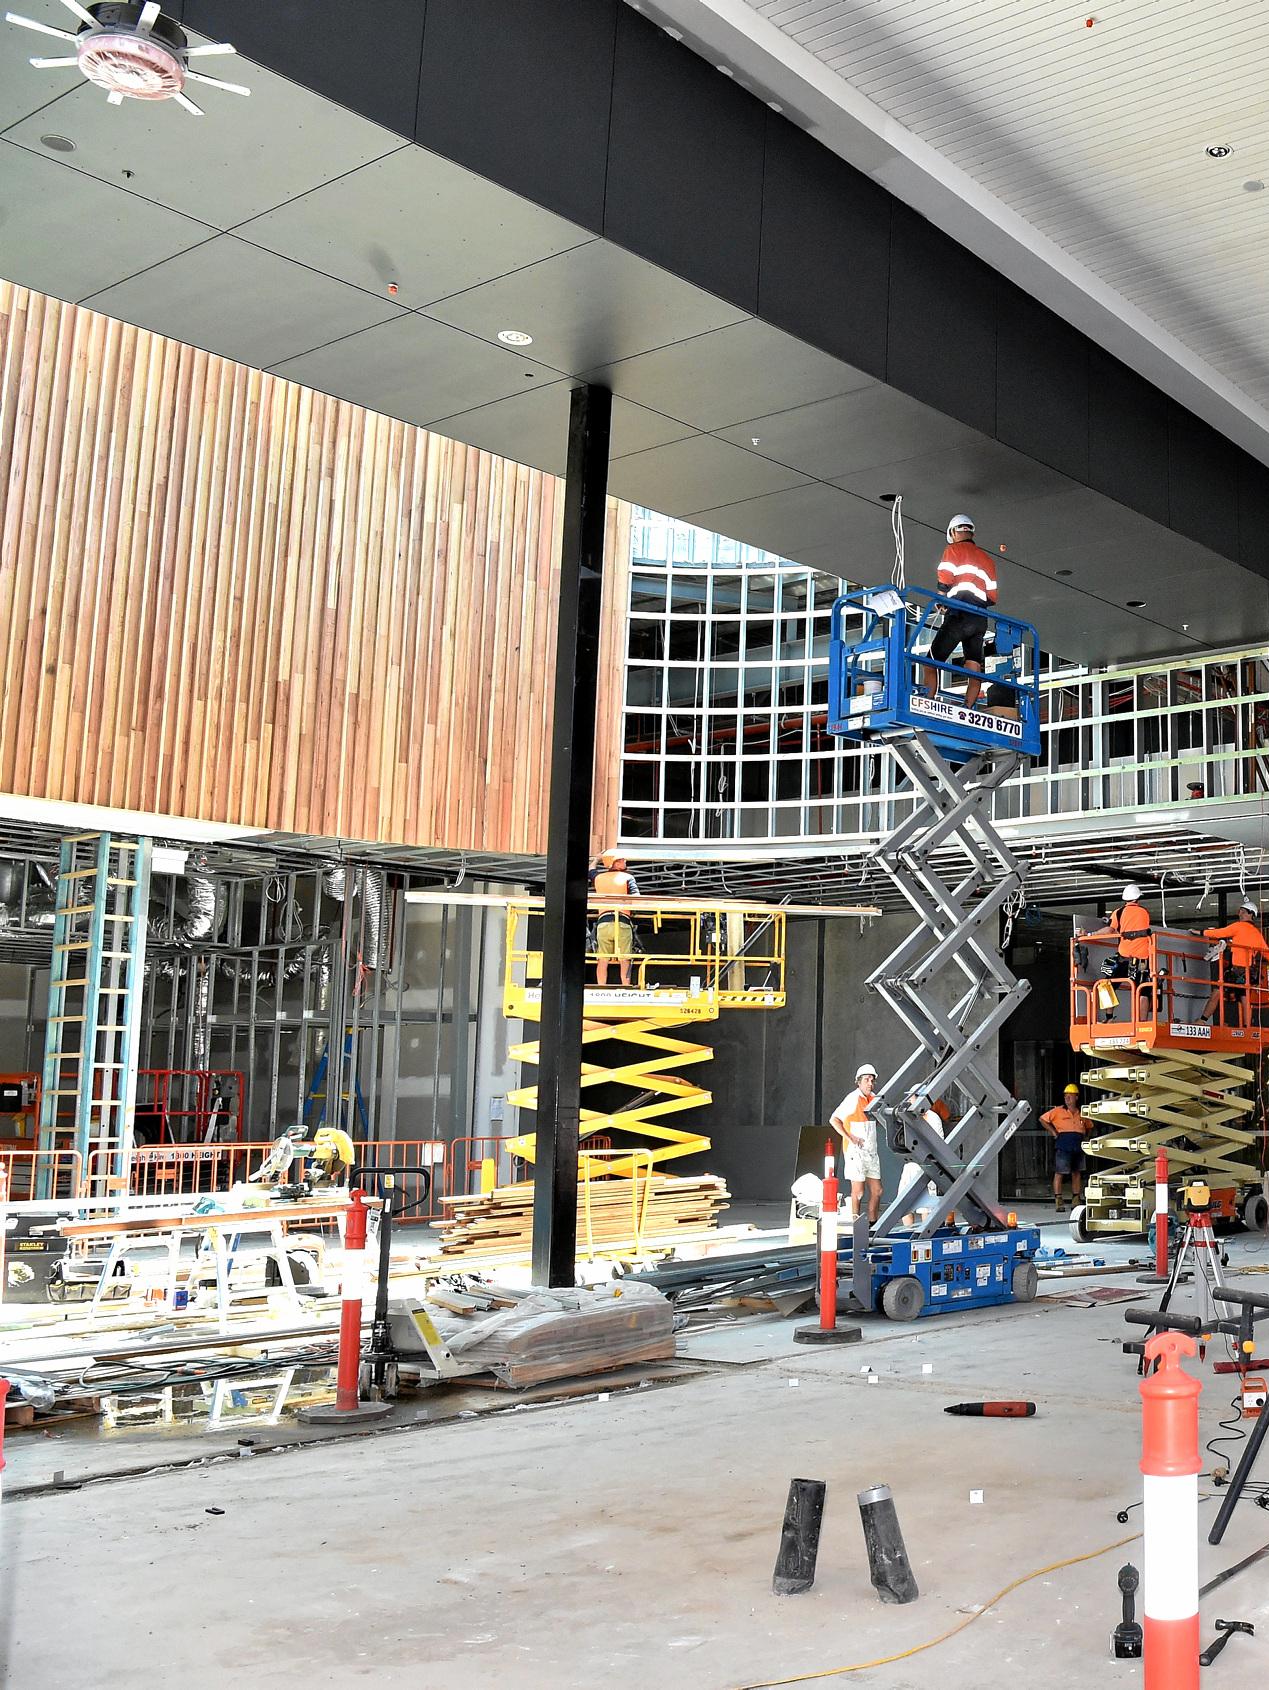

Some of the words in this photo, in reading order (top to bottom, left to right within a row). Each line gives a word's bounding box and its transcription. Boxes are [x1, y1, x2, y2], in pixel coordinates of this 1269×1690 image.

[968, 712, 994, 729] 3279
[996, 719, 1020, 736] 6770
[1186, 1026, 1197, 1036] 133
[1198, 1027, 1211, 1037] AAH
